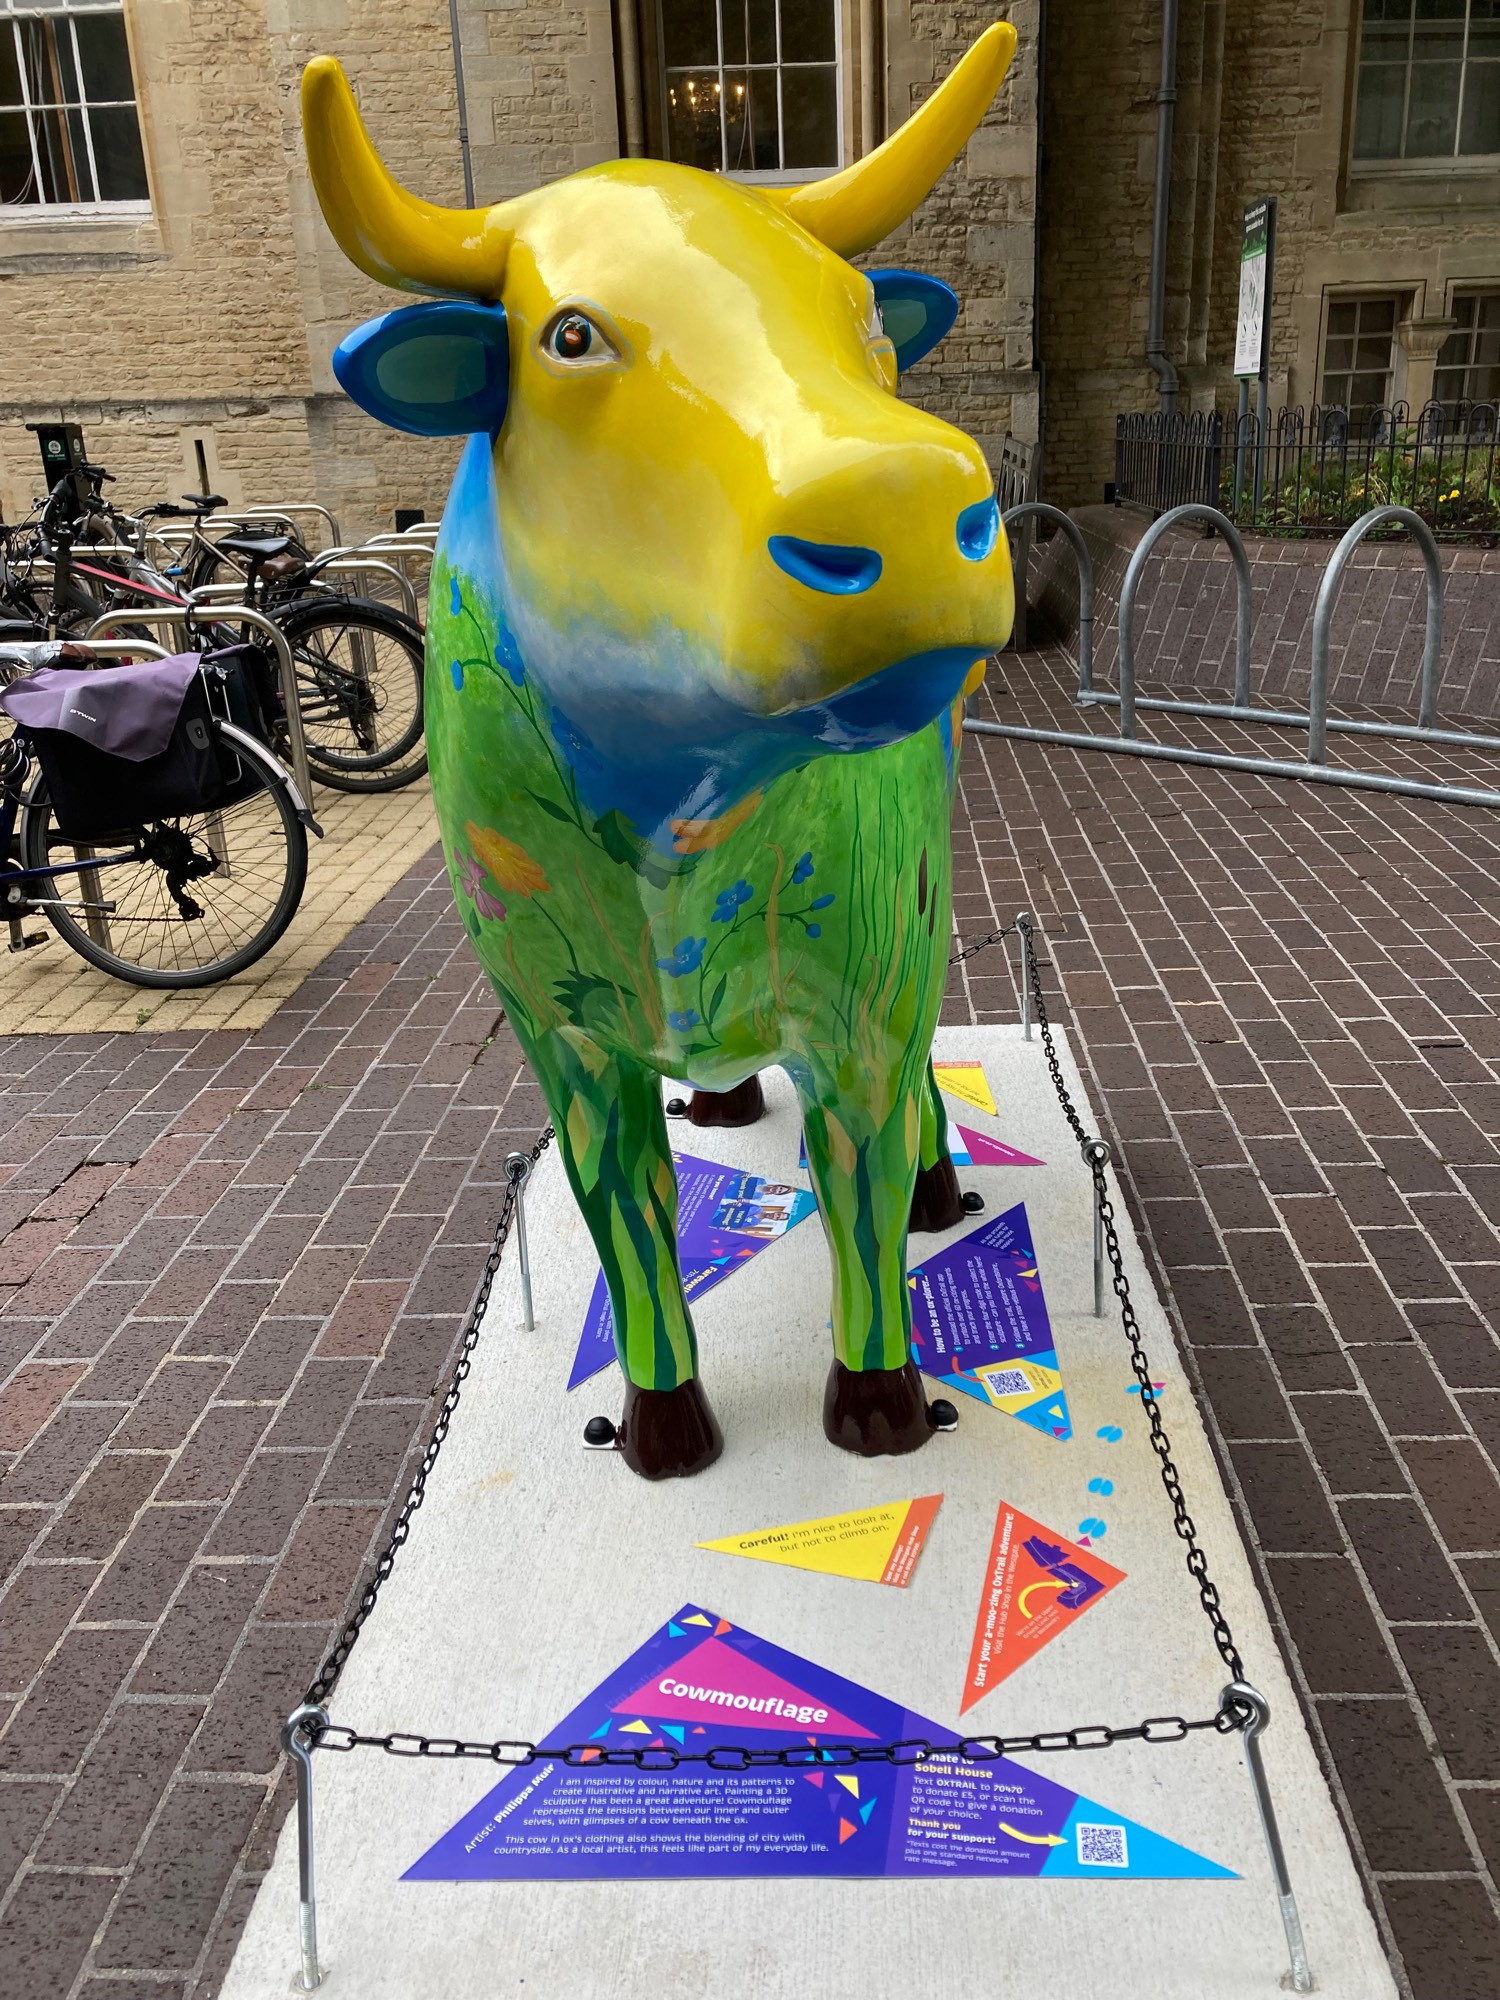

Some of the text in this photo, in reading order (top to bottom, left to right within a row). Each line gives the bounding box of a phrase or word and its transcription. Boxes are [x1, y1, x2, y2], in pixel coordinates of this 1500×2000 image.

[922, 1275, 946, 1353] How to be an ox-plorer...
[739, 1533, 789, 1549] Careful!
[792, 1530, 810, 1538] I'm
[813, 1525, 835, 1534] nice
[852, 1516, 877, 1526] look
[880, 1513, 895, 1521] at,
[780, 1525, 889, 1552] but not to climb on.
[1006, 1574, 1014, 1584] the
[974, 1513, 1014, 1687] Start your a-moo-zing OxTrail adventure!
[1001, 1593, 1012, 1609] Shop
[999, 1611, 1008, 1625] Hub
[997, 1626, 1005, 1638] the
[993, 1639, 1003, 1654] Visit
[659, 1679, 828, 1723] Cowmouflage
[916, 1751, 959, 1763] Dnate
[915, 1763, 993, 1778] Sobell House
[566, 1778, 581, 1786] am
[584, 1778, 621, 1786] inspired
[624, 1777, 635, 1786] by
[638, 1778, 668, 1786] colour,
[742, 1778, 782, 1786] patterns
[914, 1776, 933, 1785] Text
[936, 1778, 977, 1789] OXTRAIL
[552, 1787, 583, 1796] create
[586, 1787, 635, 1795] illustrative
[638, 1787, 656, 1795] and
[658, 1787, 701, 1795] narrative
[725, 1788, 763, 1796] Painting
[912, 1786, 922, 1794] to
[925, 1788, 958, 1797] donate
[961, 1791, 976, 1800] £5,
[993, 1795, 1016, 1803] scan
[1019, 1797, 1035, 1805] the
[543, 1796, 588, 1806] sculpture
[590, 1796, 607, 1805] has
[610, 1796, 633, 1804] been
[644, 1797, 670, 1805] great
[727, 1797, 792, 1805] Cowmouflage
[911, 1796, 925, 1804] QR
[954, 1800, 965, 1808] to
[968, 1802, 988, 1810] give
[999, 1805, 1043, 1816] donation
[465, 1763, 554, 1853] Artist: Philippa Muir
[532, 1806, 584, 1816] represents
[588, 1806, 604, 1814] the
[606, 1806, 646, 1814] tensions
[649, 1806, 691, 1814] between
[742, 1806, 760, 1814] and
[948, 1809, 982, 1819] choice.
[523, 1817, 555, 1826] selves,
[558, 1817, 580, 1825] with
[583, 1816, 625, 1826] glimpses
[628, 1816, 638, 1824] of
[673, 1816, 712, 1824] beneath
[715, 1816, 731, 1824] the
[909, 1818, 961, 1830] Thank you
[505, 1834, 524, 1844] This
[527, 1836, 548, 1844] cow
[550, 1834, 560, 1843] in
[562, 1835, 582, 1843] ox's
[585, 1834, 624, 1844] clothing
[627, 1834, 647, 1842] also
[650, 1834, 681, 1842] shows
[685, 1834, 701, 1842] the
[704, 1834, 745, 1843] blending
[762, 1834, 780, 1842] city
[908, 1828, 996, 1844] for your support!
[494, 1845, 554, 1856] countryside.
[556, 1845, 569, 1854] As
[581, 1845, 603, 1853] local
[606, 1845, 636, 1854] artist,
[662, 1844, 685, 1852] feels
[688, 1844, 705, 1852] like
[708, 1844, 729, 1853] part
[732, 1844, 743, 1852] of
[746, 1845, 761, 1853] my
[764, 1844, 808, 1852] everyday
[965, 1846, 998, 1855] donation
[1000, 1850, 1030, 1859] amount
[922, 1858, 957, 1866] message.
[940, 1852, 974, 1860] standard
[976, 1856, 1009, 1864] network
